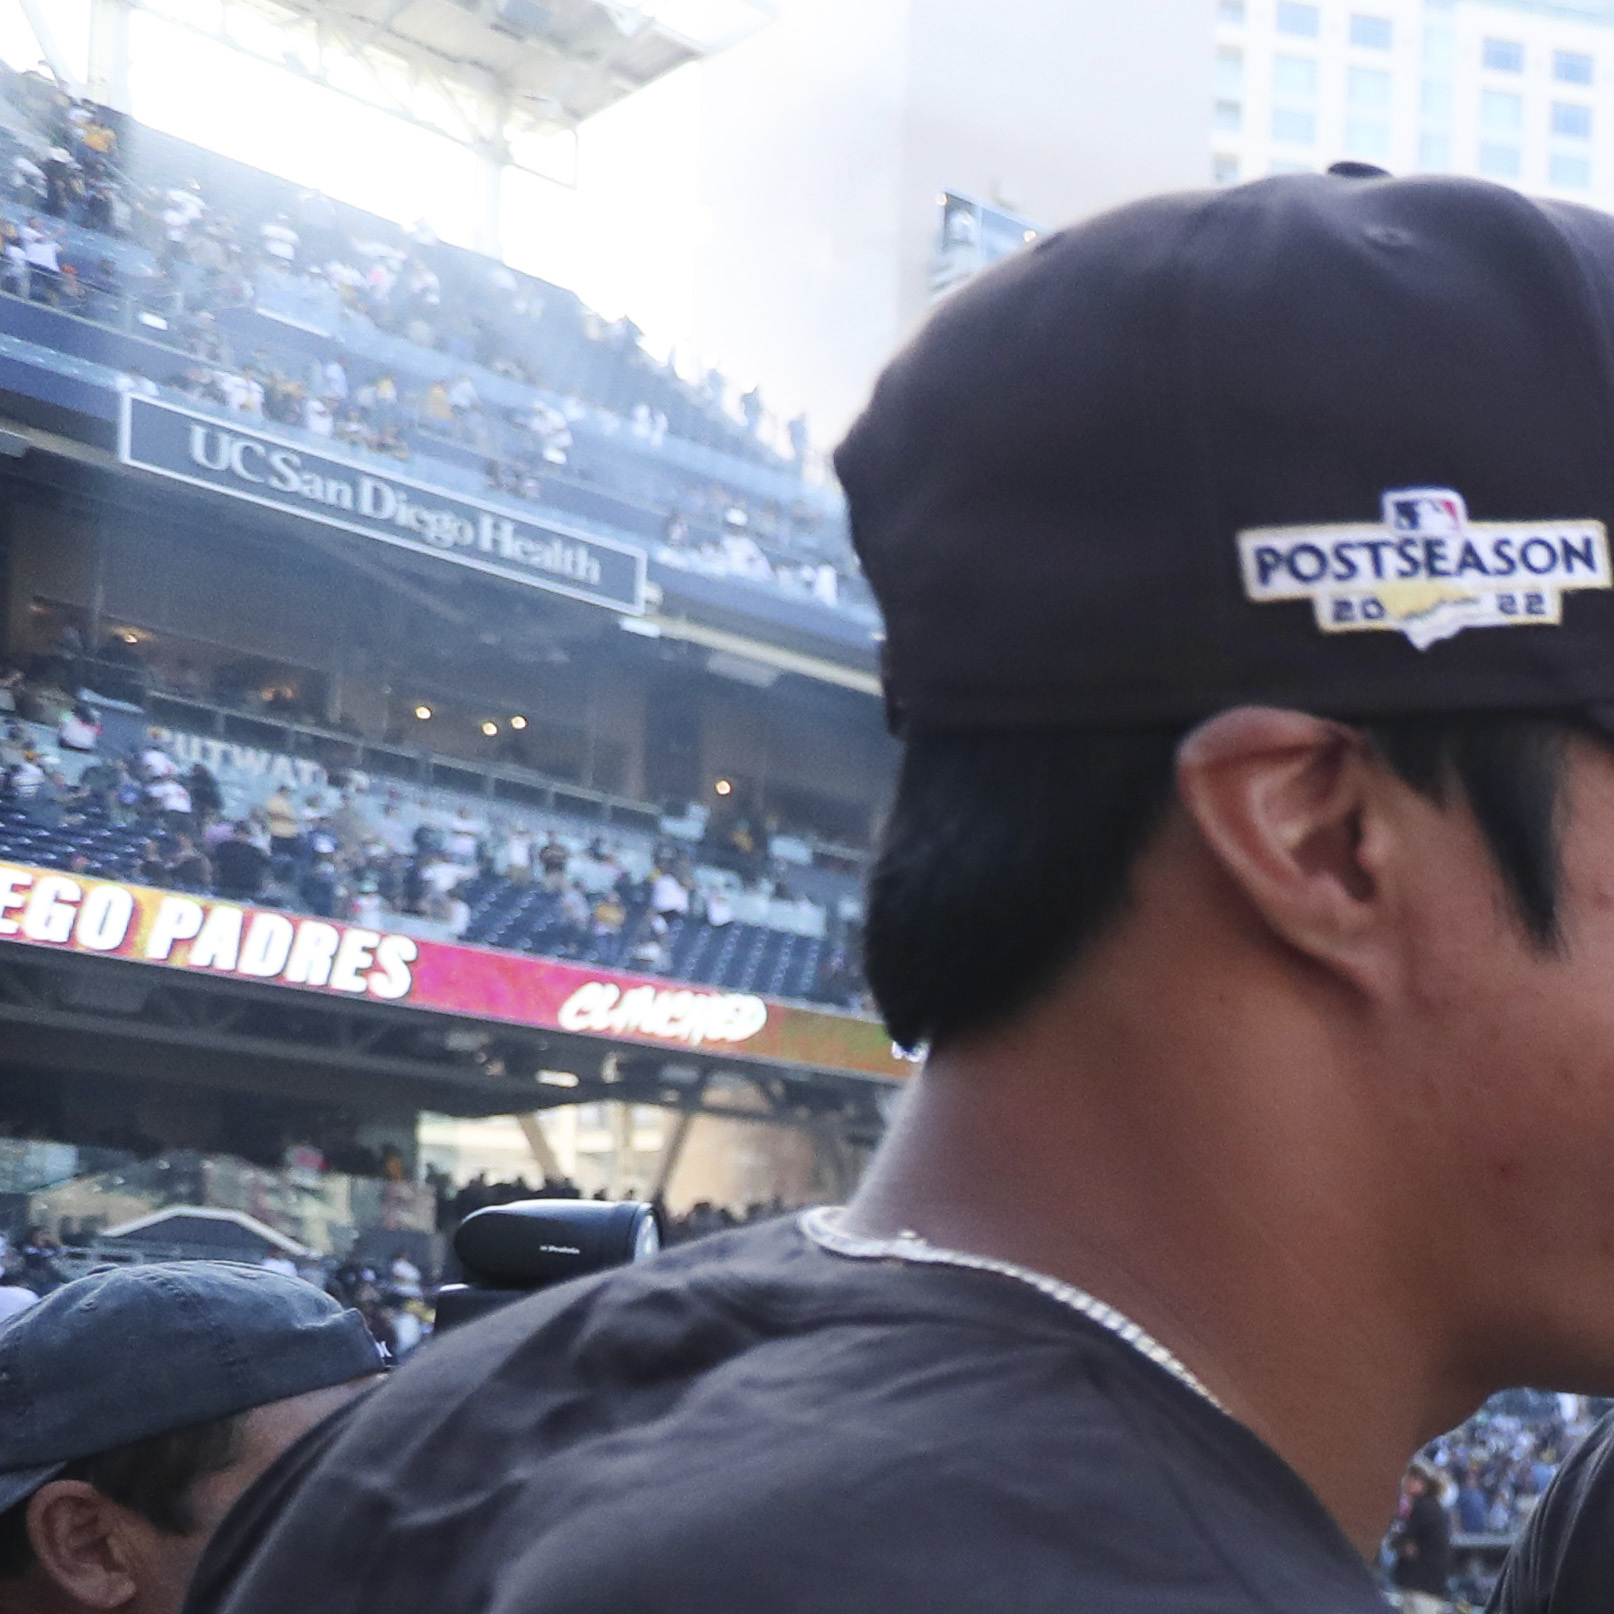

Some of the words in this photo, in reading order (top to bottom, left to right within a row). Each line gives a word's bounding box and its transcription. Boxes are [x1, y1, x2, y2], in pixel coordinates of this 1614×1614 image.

[190, 424, 268, 484] UC
[267, 452, 352, 510] San
[355, 477, 475, 550] Diego
[476, 516, 601, 586] Health
[1254, 536, 1597, 587] POSTSEASON
[146, 896, 418, 999] PADRES
